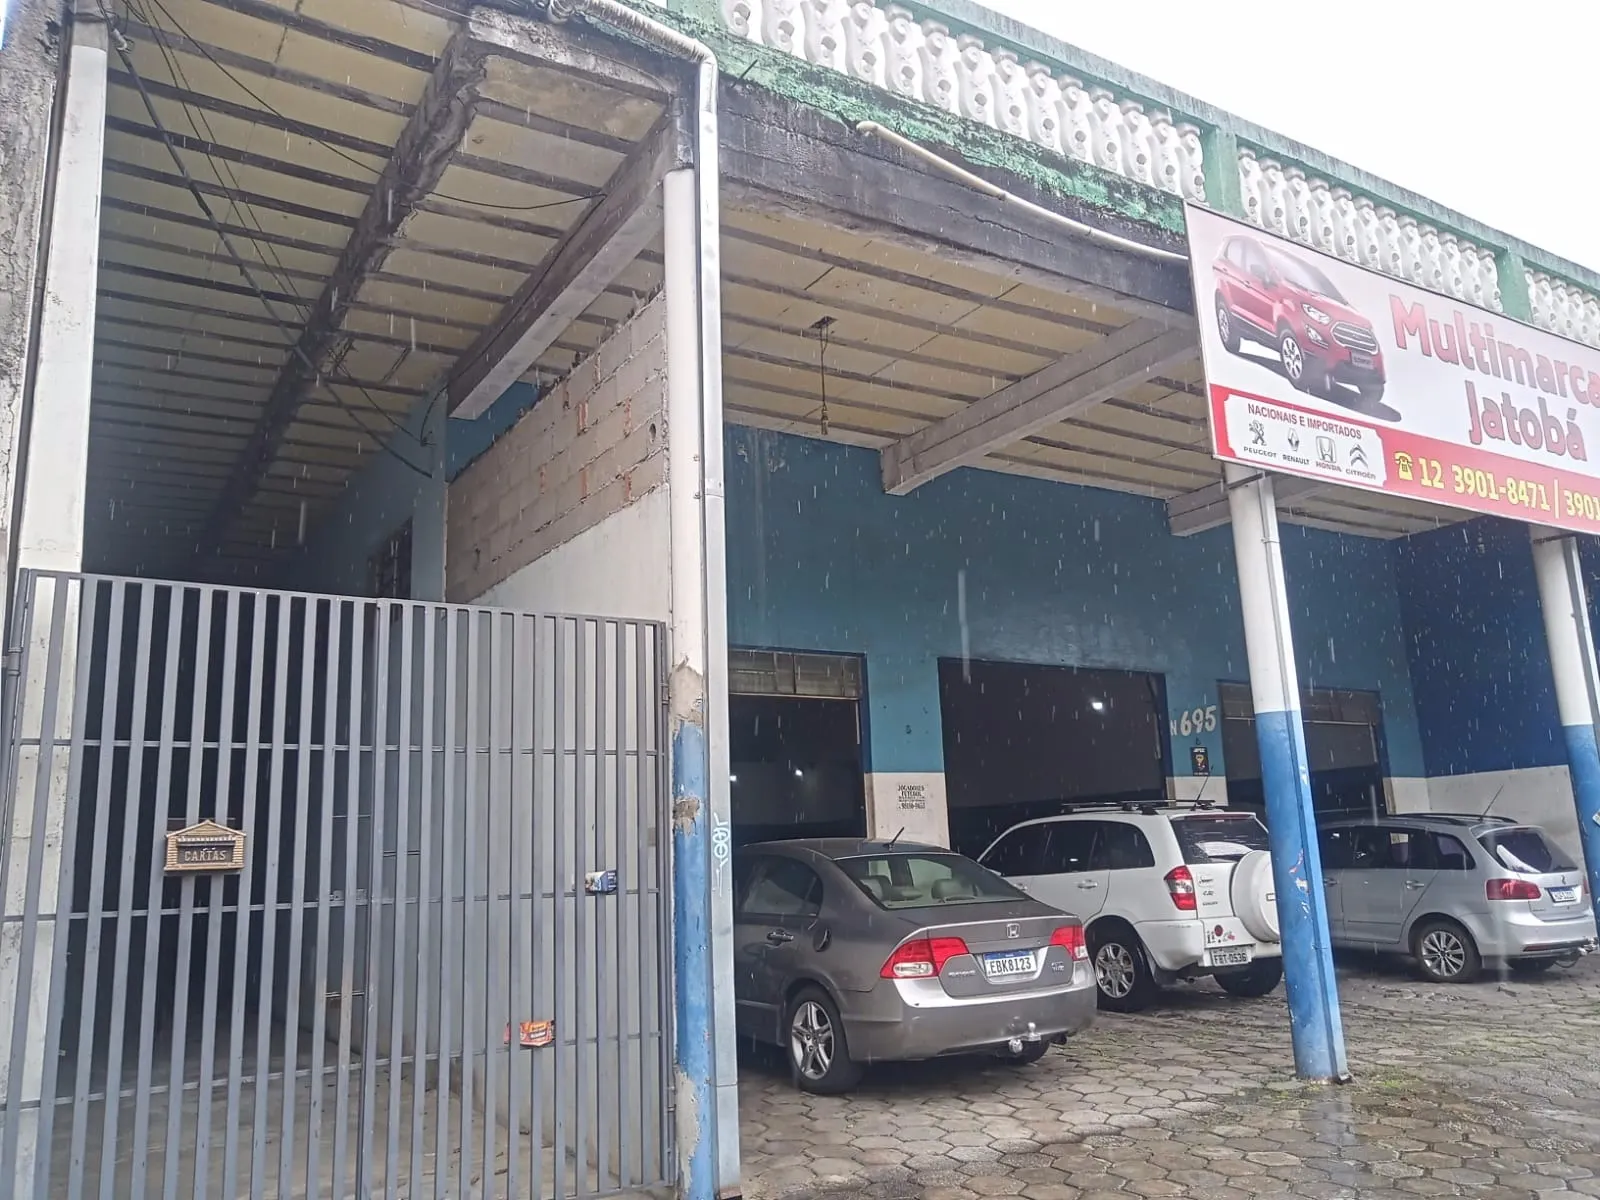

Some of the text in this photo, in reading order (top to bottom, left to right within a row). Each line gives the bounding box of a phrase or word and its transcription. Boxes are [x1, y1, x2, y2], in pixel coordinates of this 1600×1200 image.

[1247, 403, 1362, 439] NACIONAIS E IMPORTADOS
[1464, 379, 1587, 462] Jatobá
[1243, 446, 1277, 458] PEUGEOT
[1282, 453, 1310, 466] RENAULT
[1315, 461, 1342, 472] HONDA
[1418, 457, 1445, 490] 12
[1451, 464, 1551, 512] 3901-8471
[1180, 704, 1217, 737] 695
[184, 850, 227, 862] CARTAS
[989, 957, 1032, 974] EBK8123
